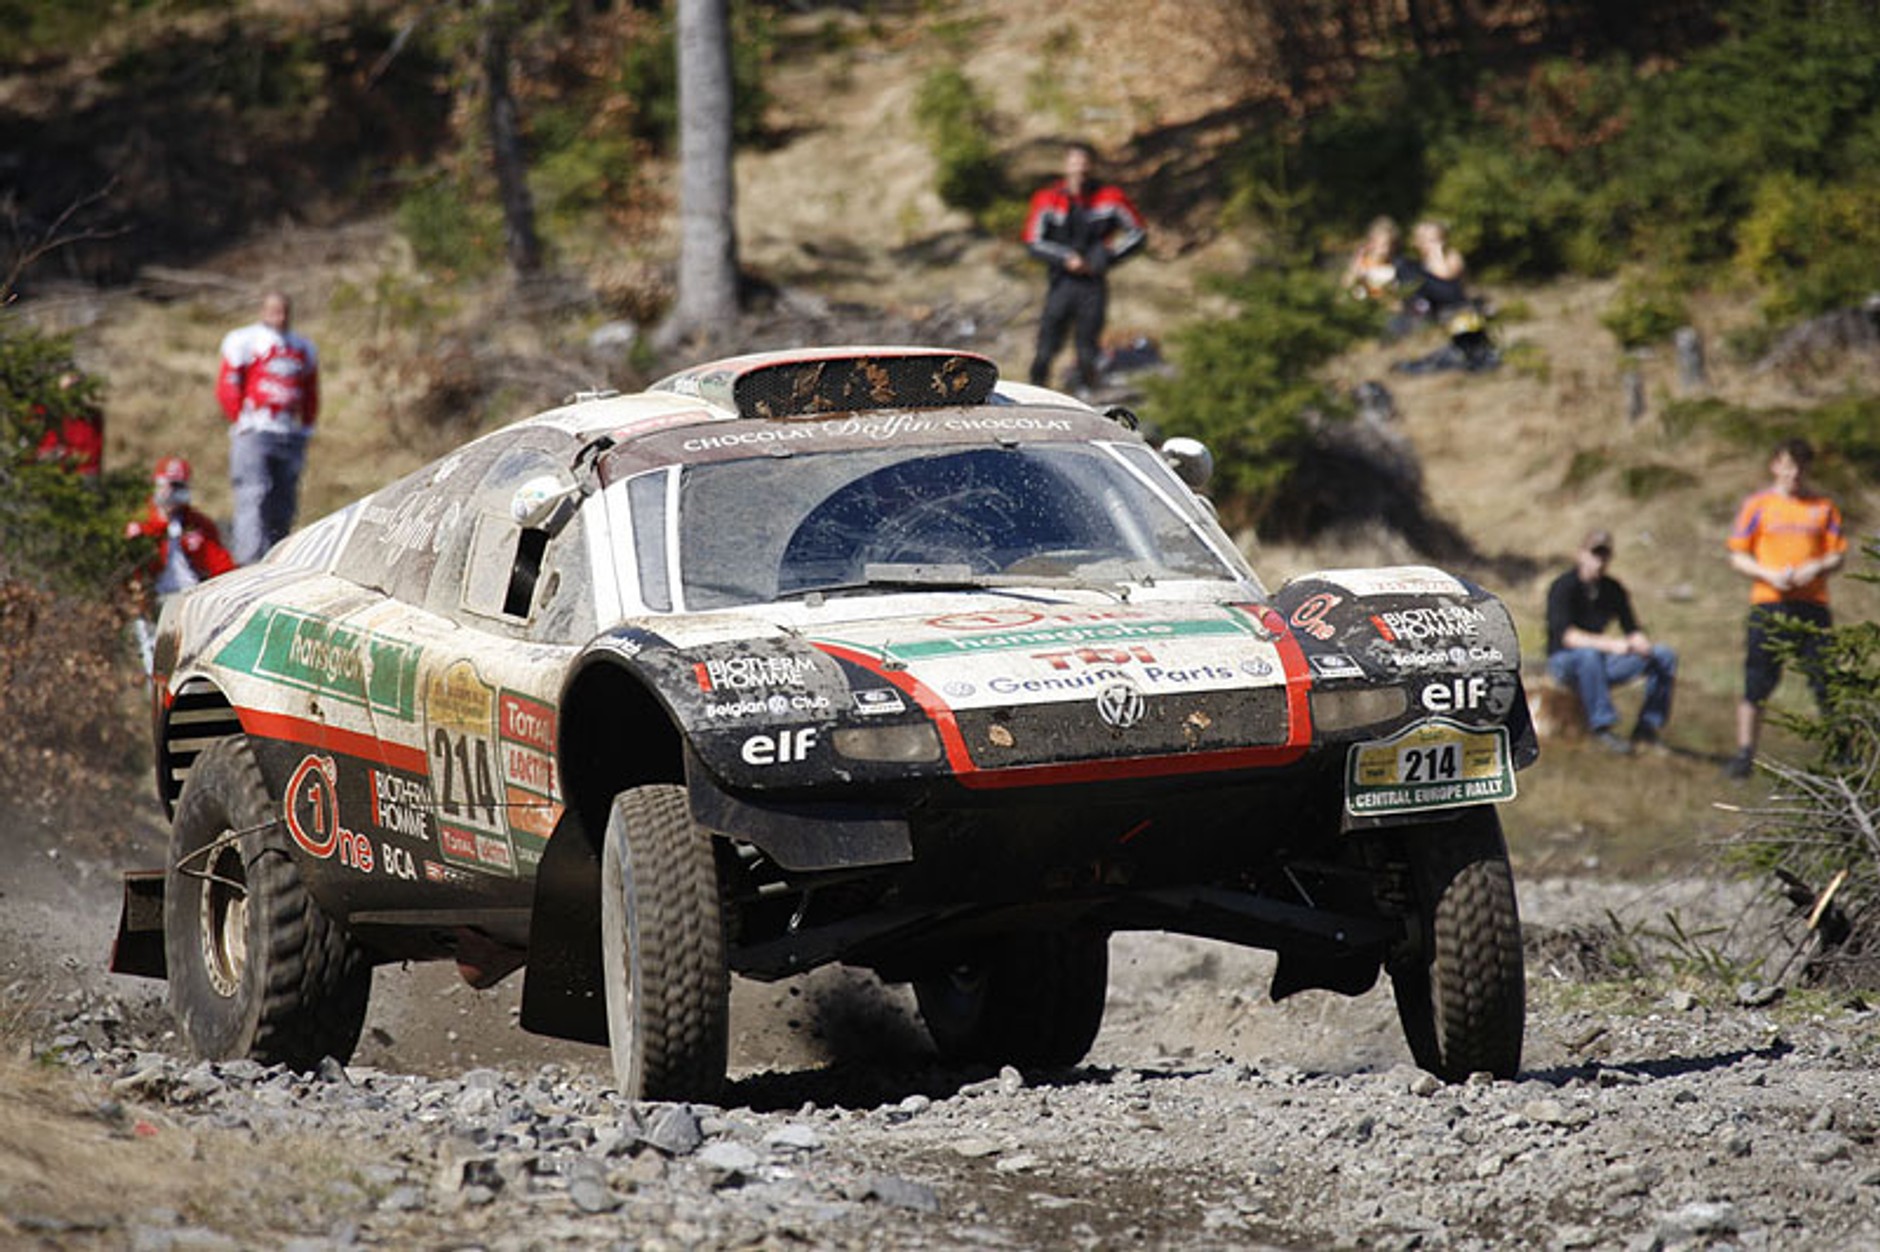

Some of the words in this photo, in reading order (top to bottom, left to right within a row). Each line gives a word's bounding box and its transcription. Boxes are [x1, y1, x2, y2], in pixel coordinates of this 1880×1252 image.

[683, 426, 814, 452] CHOCOLAT
[944, 417, 1073, 433] CHOCOLAT
[1382, 607, 1486, 627] BIOTHERM
[1392, 621, 1480, 641] HOMME
[951, 624, 1174, 649] hansgrohe
[706, 658, 816, 673] BIOTHERM
[1030, 646, 1157, 670] TDI
[711, 671, 805, 690] HOMME
[1145, 664, 1234, 683] Parts
[706, 699, 768, 718] Belgian
[791, 696, 830, 710] Club
[1421, 678, 1487, 711] elf
[506, 702, 554, 746] TOTAL
[741, 728, 817, 766] elf
[434, 727, 497, 826] 214
[1405, 746, 1457, 782] 214
[1355, 792, 1412, 808] CENTRAL
[1415, 785, 1463, 802] EUROPE
[1465, 780, 1503, 797] RALLY
[379, 800, 430, 840] HOMME
[382, 843, 417, 880] BCA
